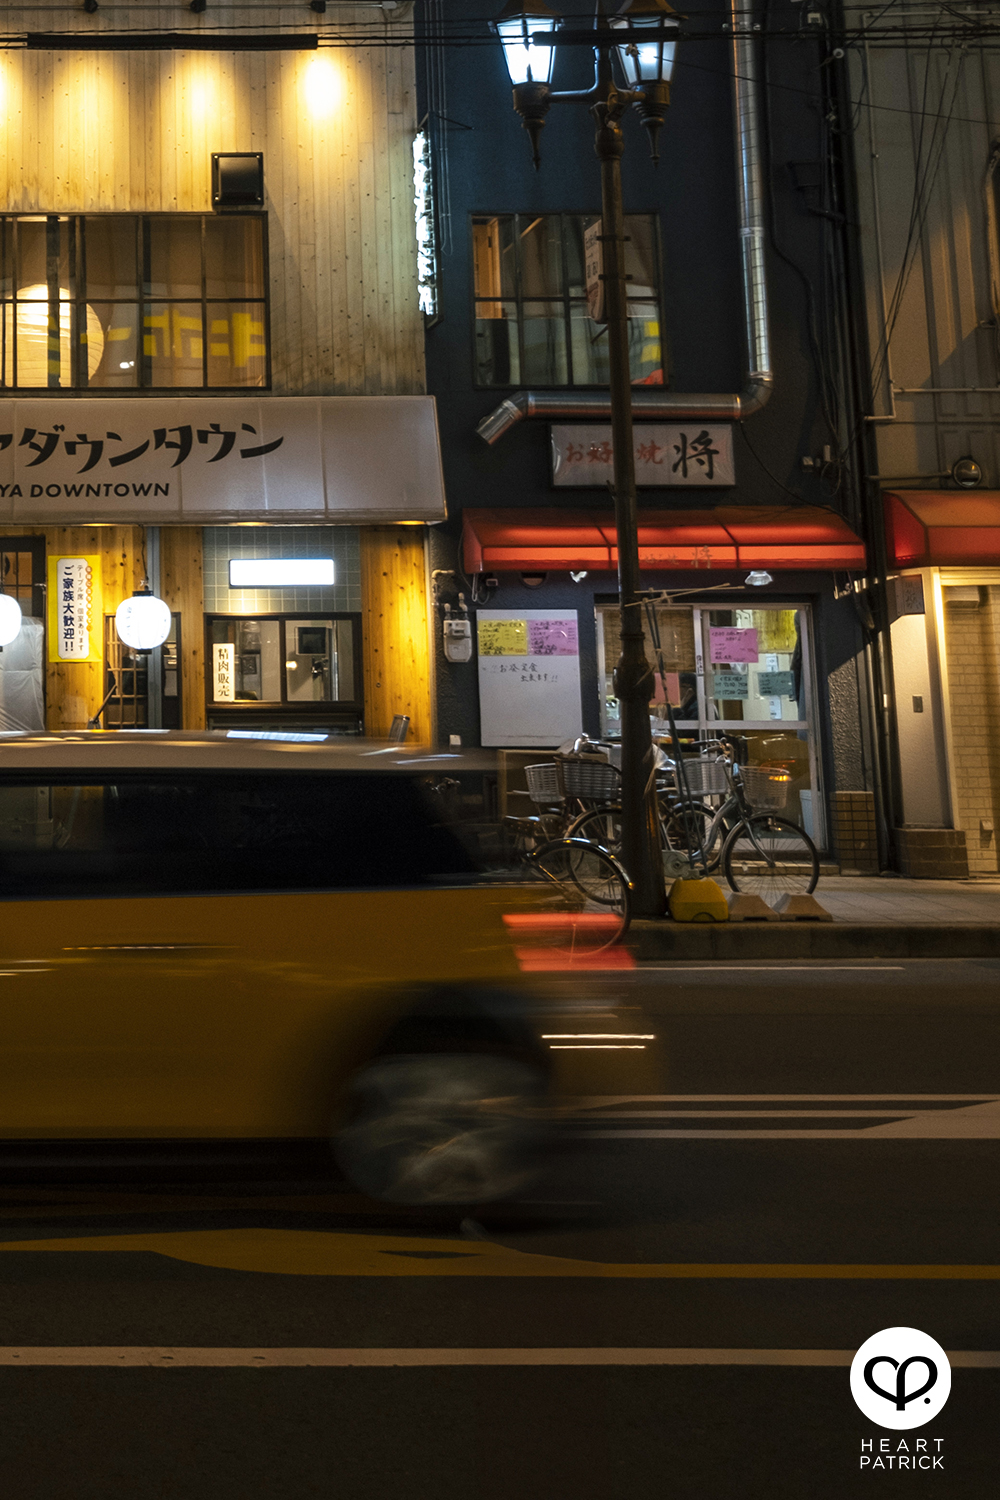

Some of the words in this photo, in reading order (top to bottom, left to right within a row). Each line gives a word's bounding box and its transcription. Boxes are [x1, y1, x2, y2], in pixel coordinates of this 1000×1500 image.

[566, 440, 664, 465] お好焼
[672, 430, 720, 480] 将
[30, 482, 170, 498] DOWNTOWN
[217, 647, 230, 698] 精肉販売
